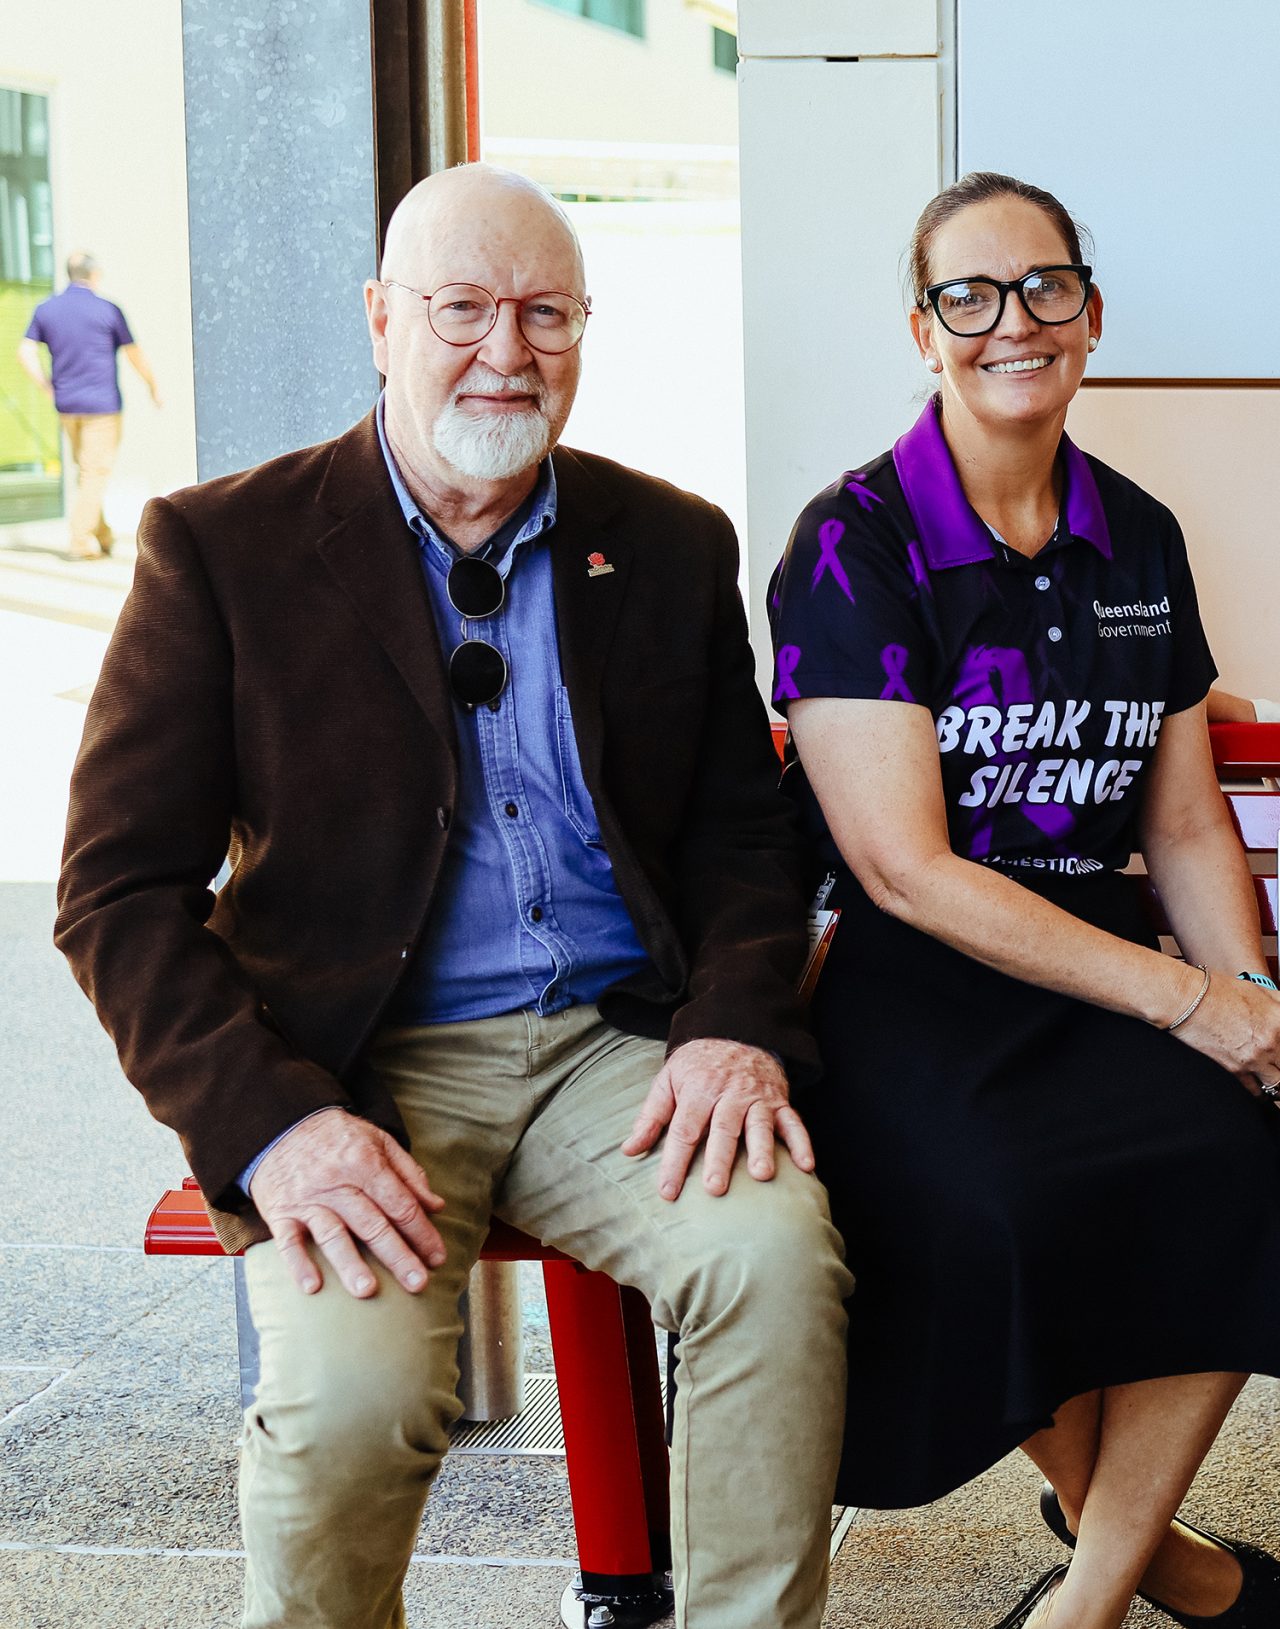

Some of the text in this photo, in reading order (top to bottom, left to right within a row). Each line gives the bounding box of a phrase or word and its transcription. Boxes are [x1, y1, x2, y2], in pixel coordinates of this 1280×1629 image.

[1093, 596, 1171, 619] Queensland
[1098, 619, 1172, 638] Government
[936, 700, 1166, 757] BREAK THE
[958, 758, 1143, 808] SILENCE
